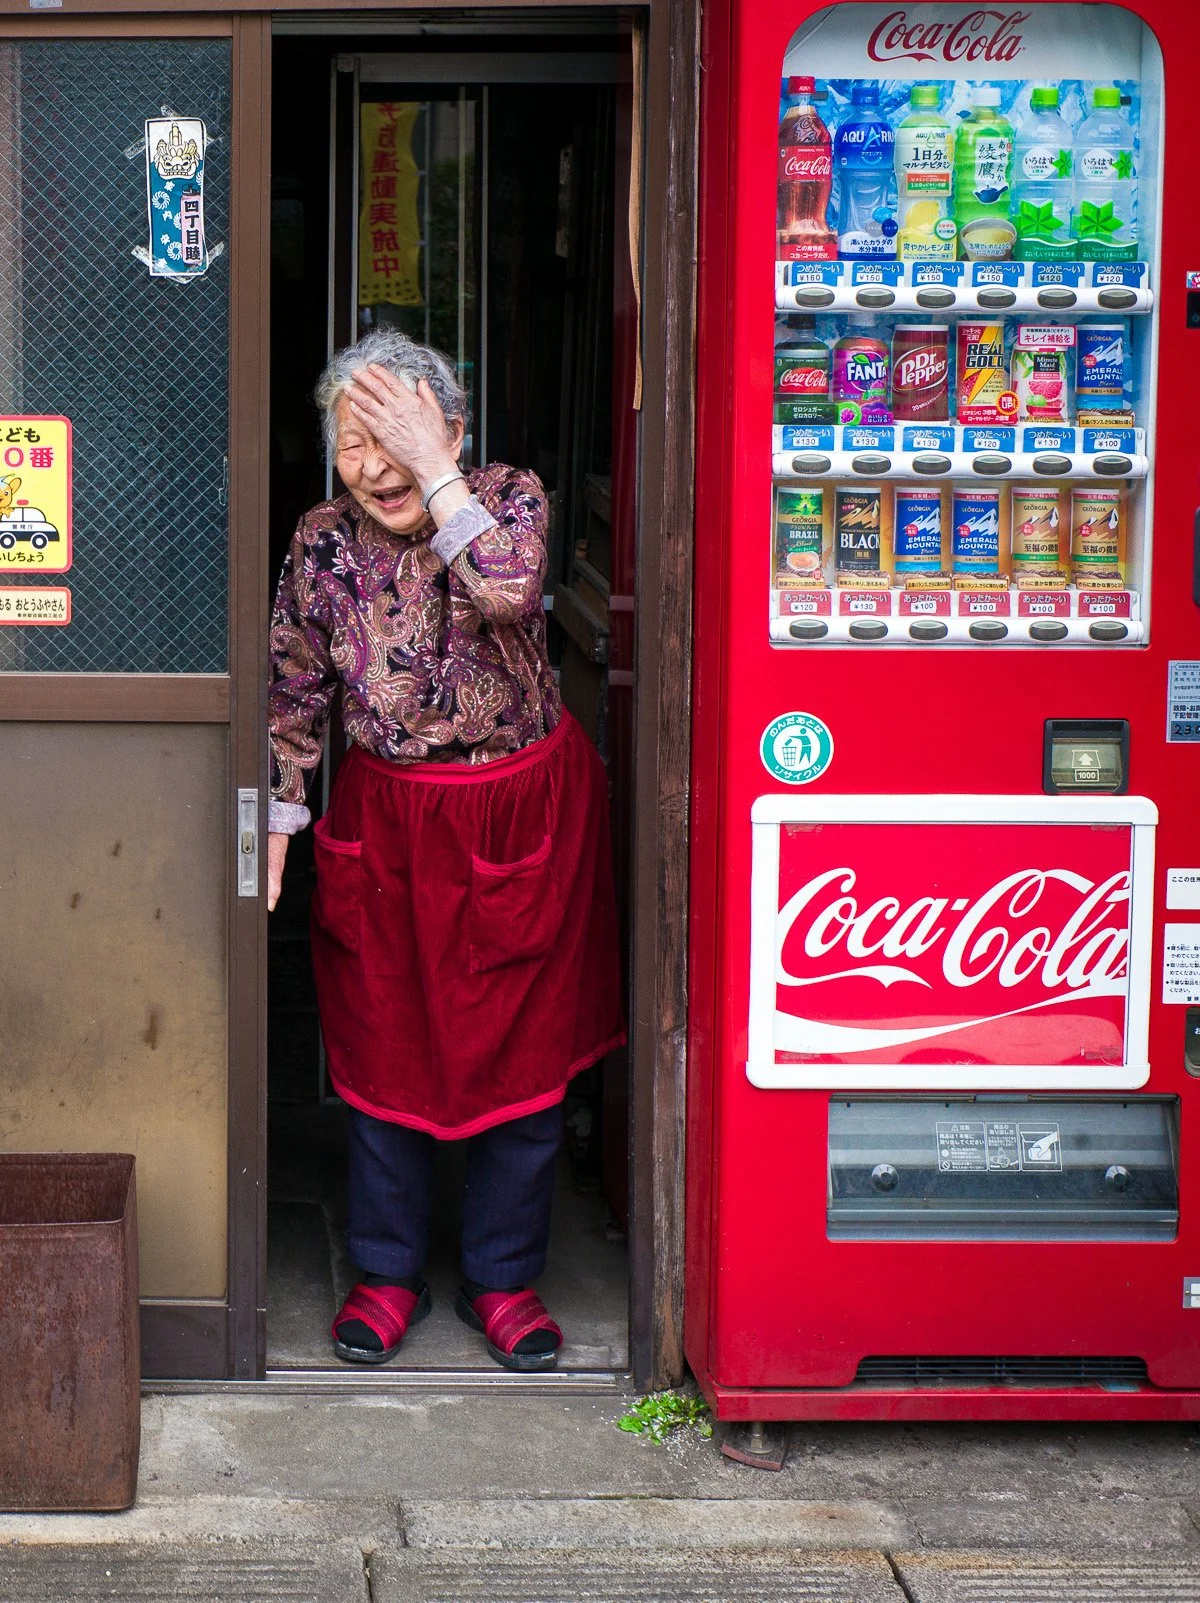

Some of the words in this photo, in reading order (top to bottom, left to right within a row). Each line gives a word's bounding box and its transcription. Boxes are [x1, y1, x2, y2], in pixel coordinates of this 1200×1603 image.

[867, 10, 1033, 62] Coca-Cola
[912, 147, 947, 161] 1日分の
[978, 143, 998, 180] 綾鷹
[997, 140, 1006, 182] あやたか
[1025, 157, 1055, 165] いろはす
[785, 156, 830, 175] Coca-Cola
[903, 161, 951, 169] マルチビタミン
[183, 199, 201, 261] 四丁目睦
[1024, 334, 1070, 343] キレイ補給を
[967, 343, 1004, 355] REAL
[915, 352, 937, 370] Dr
[780, 369, 828, 387] Coca-Cola
[847, 361, 887, 381] FANTA
[901, 359, 946, 386] Pepper
[790, 531, 818, 539] BRAZIL
[15, 598, 65, 612] おとうふやさん
[769, 716, 824, 738] のんだあとは
[774, 764, 821, 780] リサイクル
[776, 867, 1130, 989] Coca-Cola
